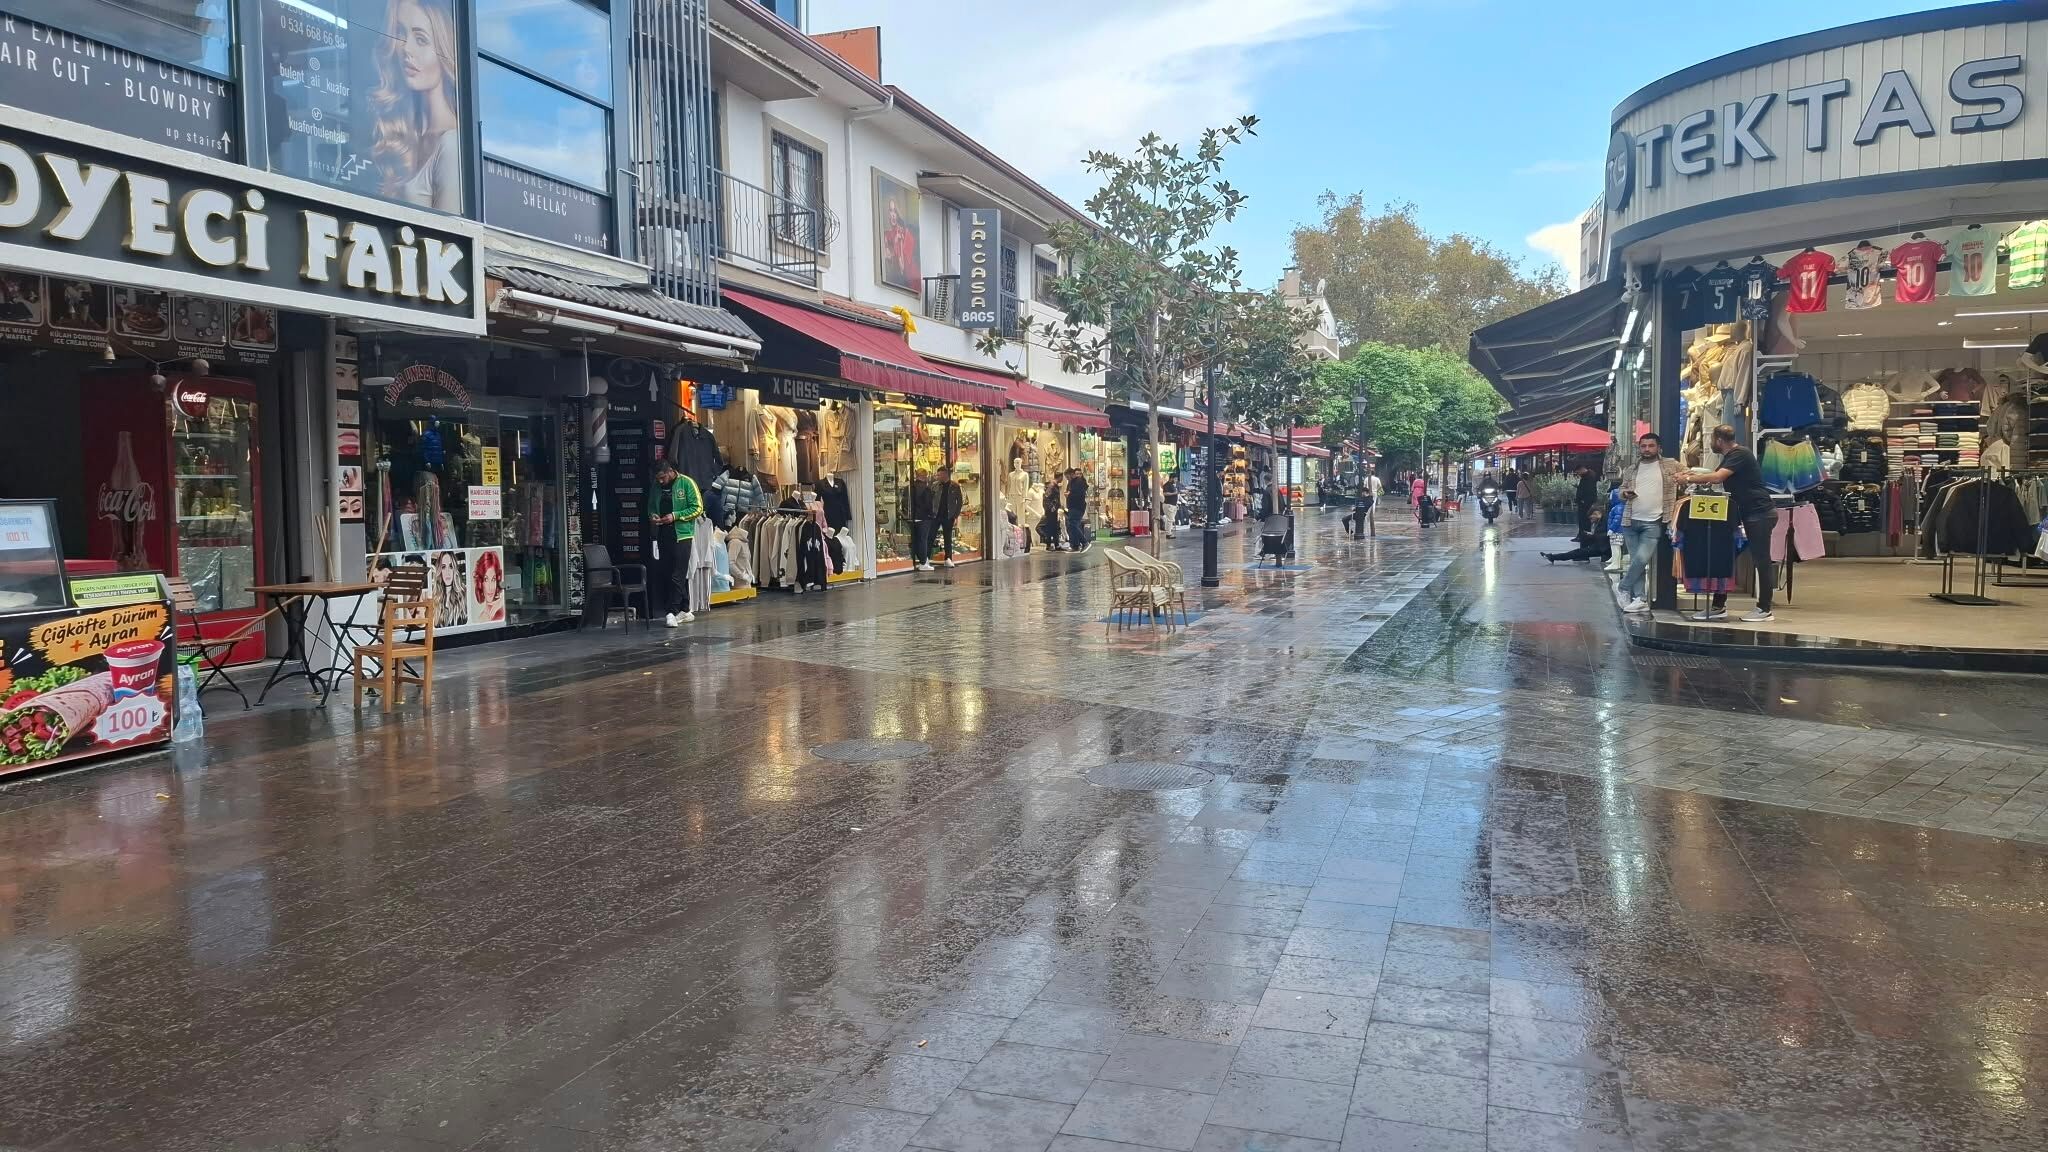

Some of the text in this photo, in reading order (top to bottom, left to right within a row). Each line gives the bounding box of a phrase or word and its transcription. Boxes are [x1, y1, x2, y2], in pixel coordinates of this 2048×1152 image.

[1, 42, 37, 71] AIR
[53, 56, 90, 85] CUT
[125, 78, 212, 120] BLOWDRY
[158, 63, 225, 97] CENTER
[279, 62, 350, 97] bulent_ali_kuafor
[166, 126, 223, 151] up stairs
[523, 190, 567, 217] SHELLAC
[1855, 266, 1870, 290] 10
[1903, 262, 1925, 288] 10
[1963, 252, 1983, 282] 10
[1714, 286, 1724, 310] 5
[1747, 279, 1762, 300] 10
[1800, 271, 1817, 300] 11
[962, 312, 995, 322] BAGS
[181, 391, 207, 403] Coca-Cola
[773, 377, 780, 394] X
[942, 403, 964, 420] CASA
[1697, 502, 1719, 514] 5 €
[41, 608, 158, 647] Çiğköfte Dürüm
[70, 626, 138, 652] + Ayran
[116, 643, 154, 654] Ayran
[119, 668, 155, 686] Ayran
[109, 707, 148, 733] 100
